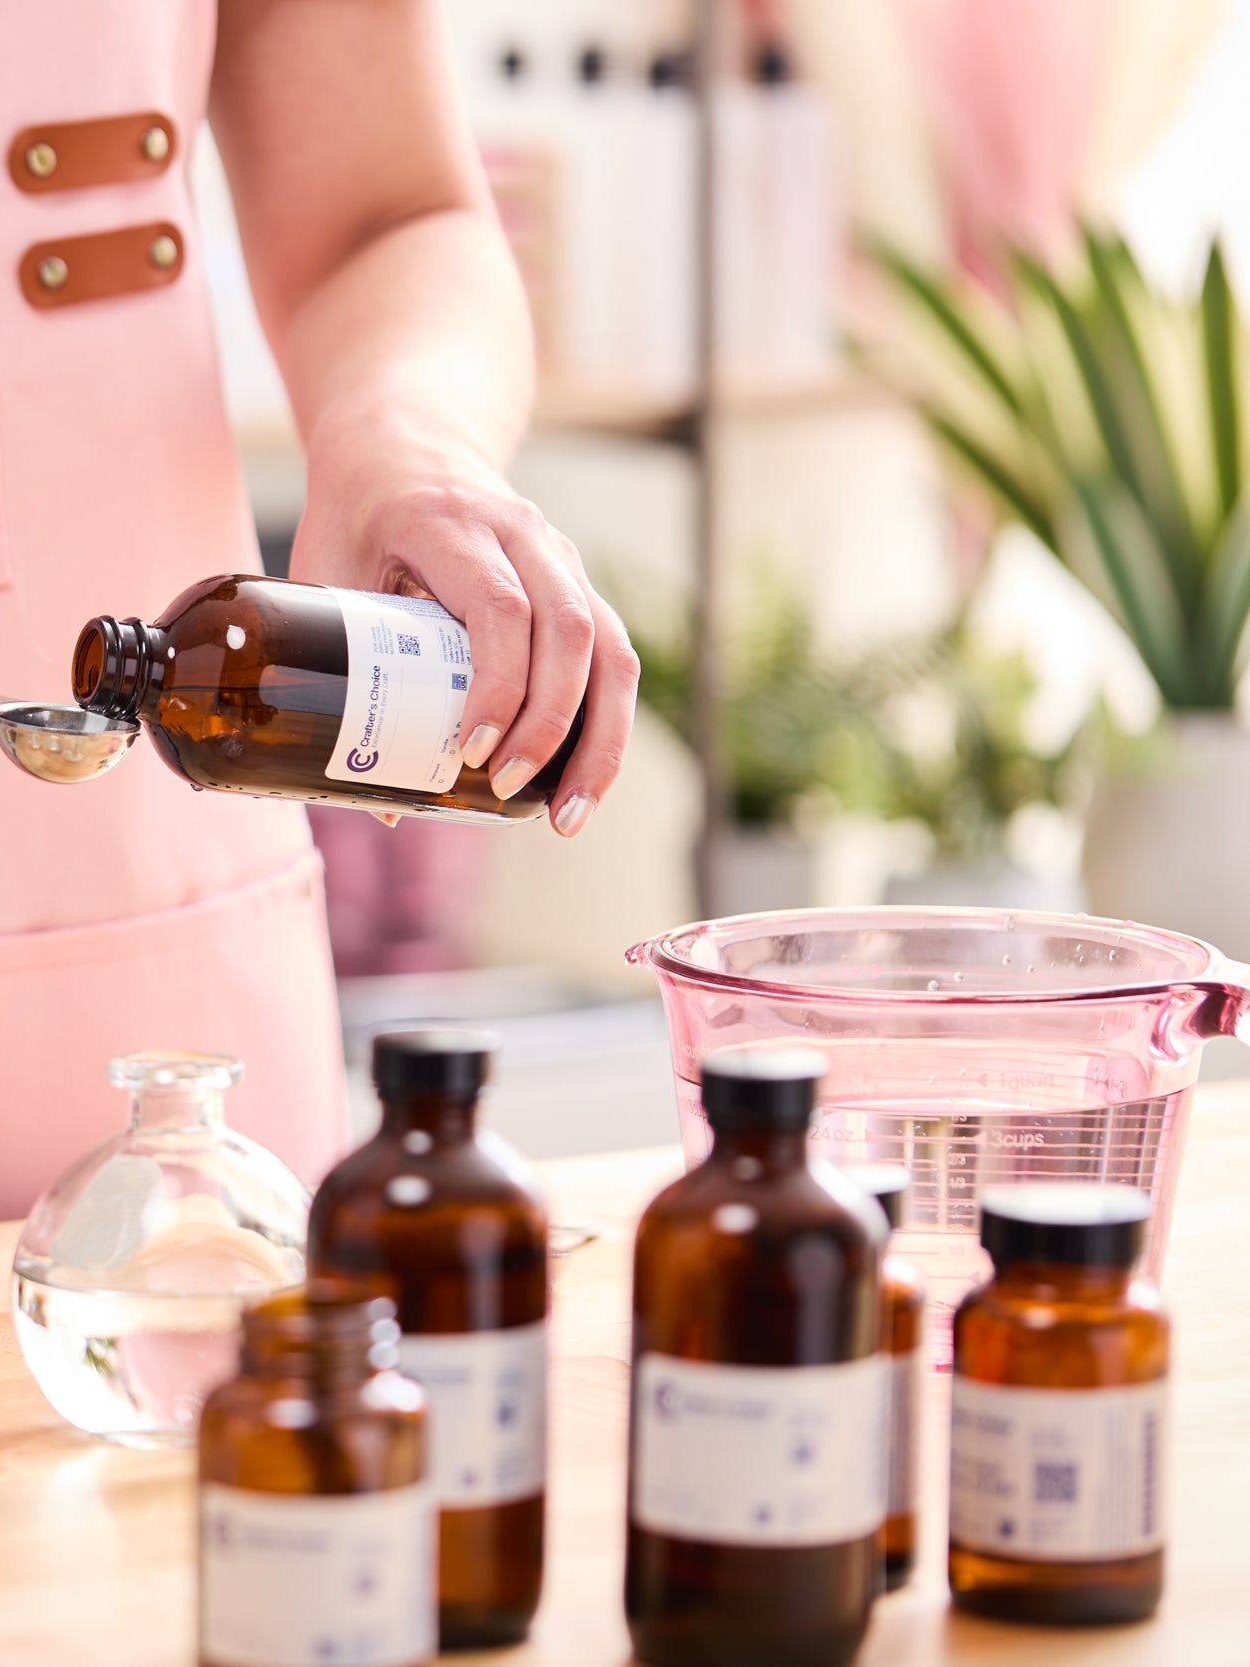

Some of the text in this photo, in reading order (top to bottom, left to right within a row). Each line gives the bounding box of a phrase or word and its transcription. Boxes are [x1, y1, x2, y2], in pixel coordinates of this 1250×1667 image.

[360, 665, 381, 747] Crafter's Choice
[458, 676, 467, 689] USA
[371, 716, 384, 748] Excellence
[380, 689, 389, 707] Every
